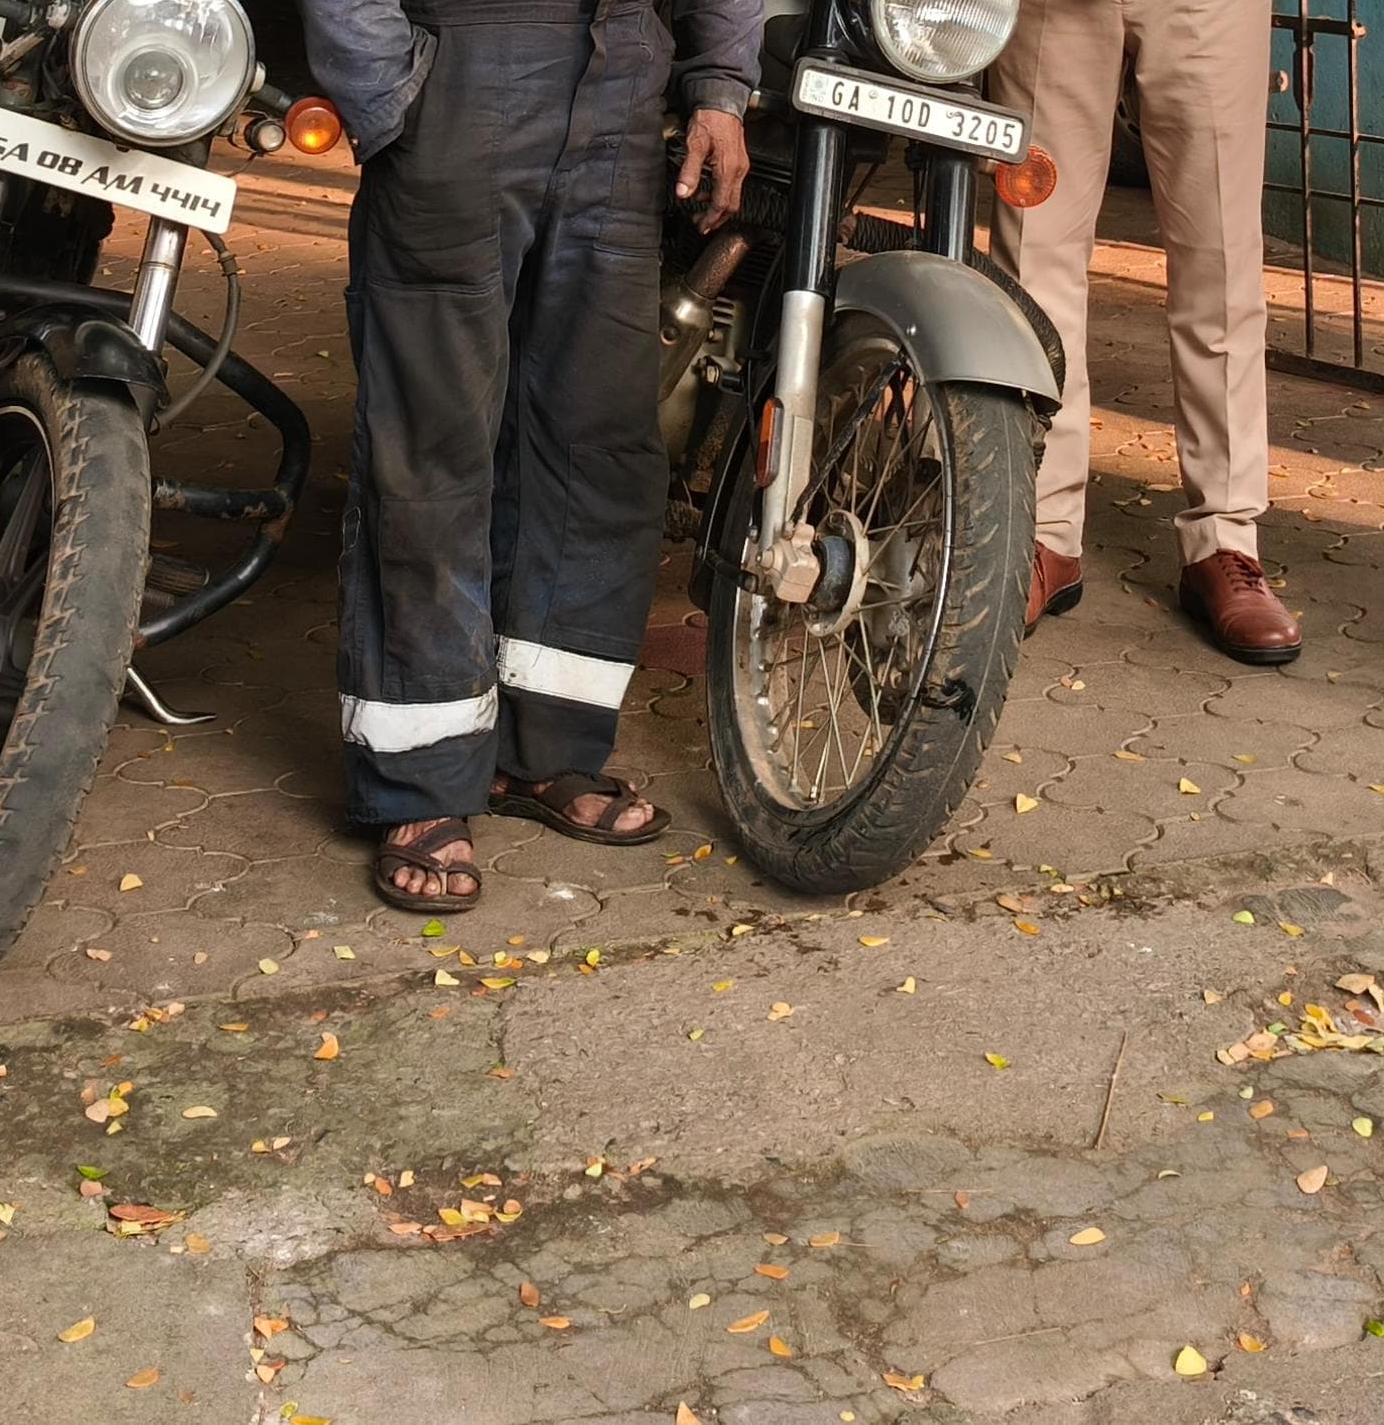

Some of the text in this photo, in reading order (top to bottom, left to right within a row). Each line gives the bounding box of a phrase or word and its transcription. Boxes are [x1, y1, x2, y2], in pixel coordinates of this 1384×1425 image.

[832, 81, 860, 111] GA
[887, 96, 931, 128] 10D
[952, 112, 1016, 148] 3205
[36, 150, 84, 176] 08
[80, 165, 144, 195] AM
[150, 183, 221, 218] 4414
